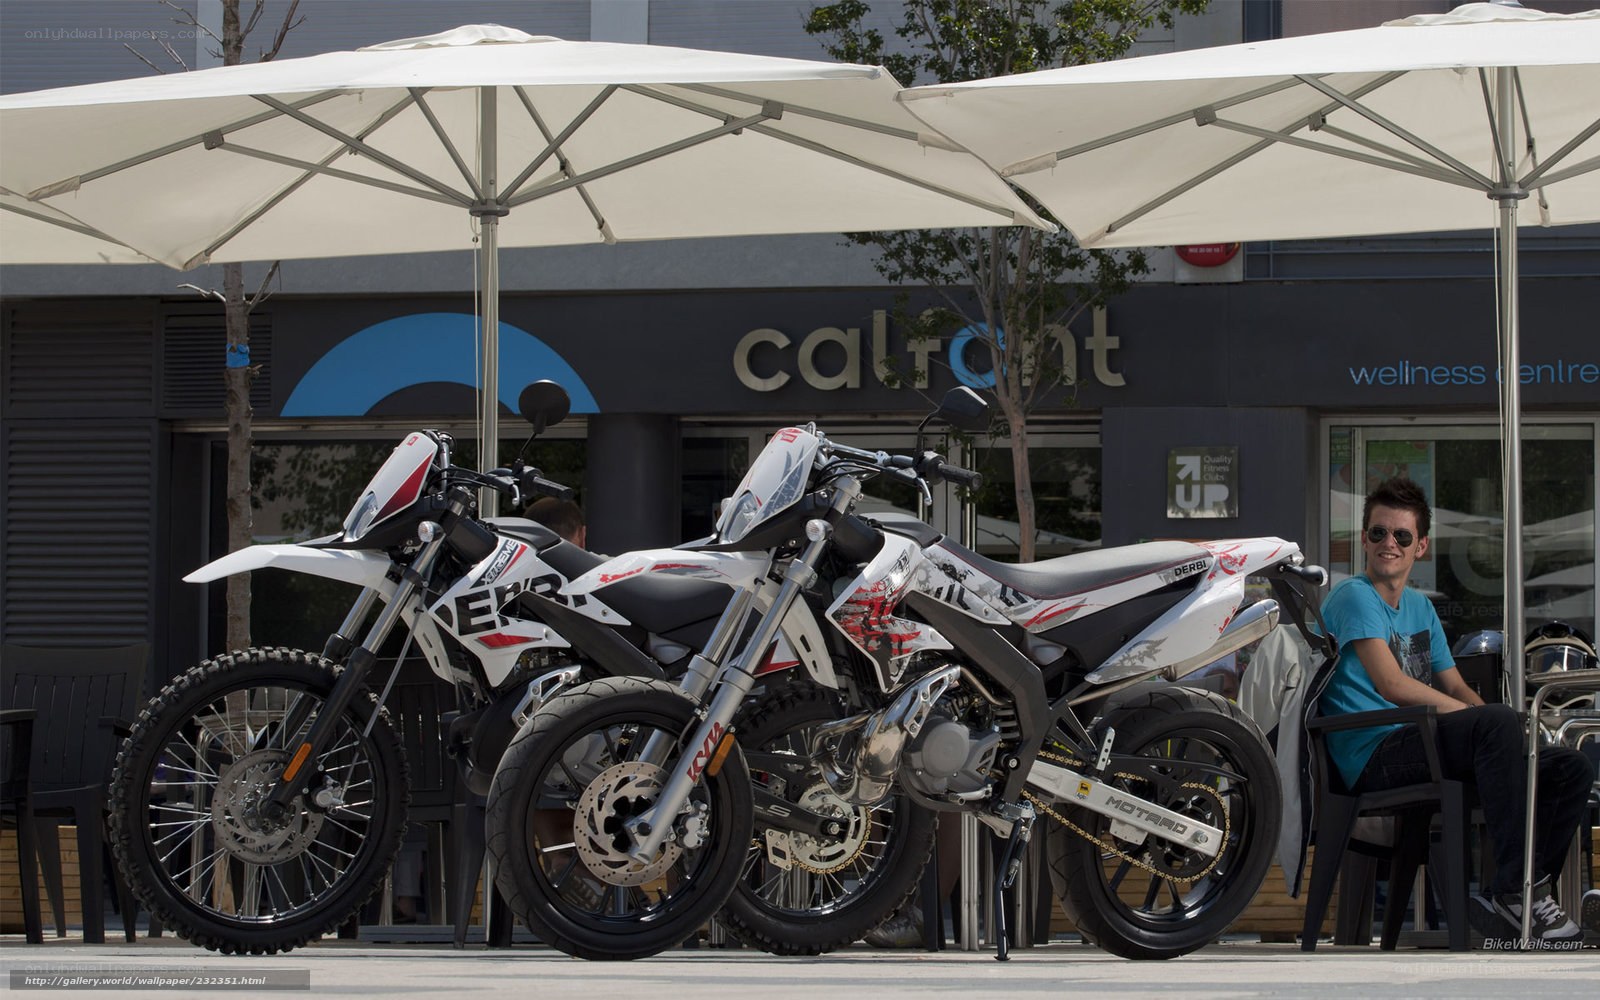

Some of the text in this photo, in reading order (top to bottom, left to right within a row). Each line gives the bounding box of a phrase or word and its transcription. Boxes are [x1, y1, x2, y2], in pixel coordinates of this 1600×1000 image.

[1348, 360, 1487, 387] wellness
[1203, 455, 1232, 464] Quality
[1175, 484, 1229, 510] UP
[1174, 559, 1207, 577] DERBI
[686, 721, 724, 782] KYB
[1105, 795, 1188, 835] MOTARD
